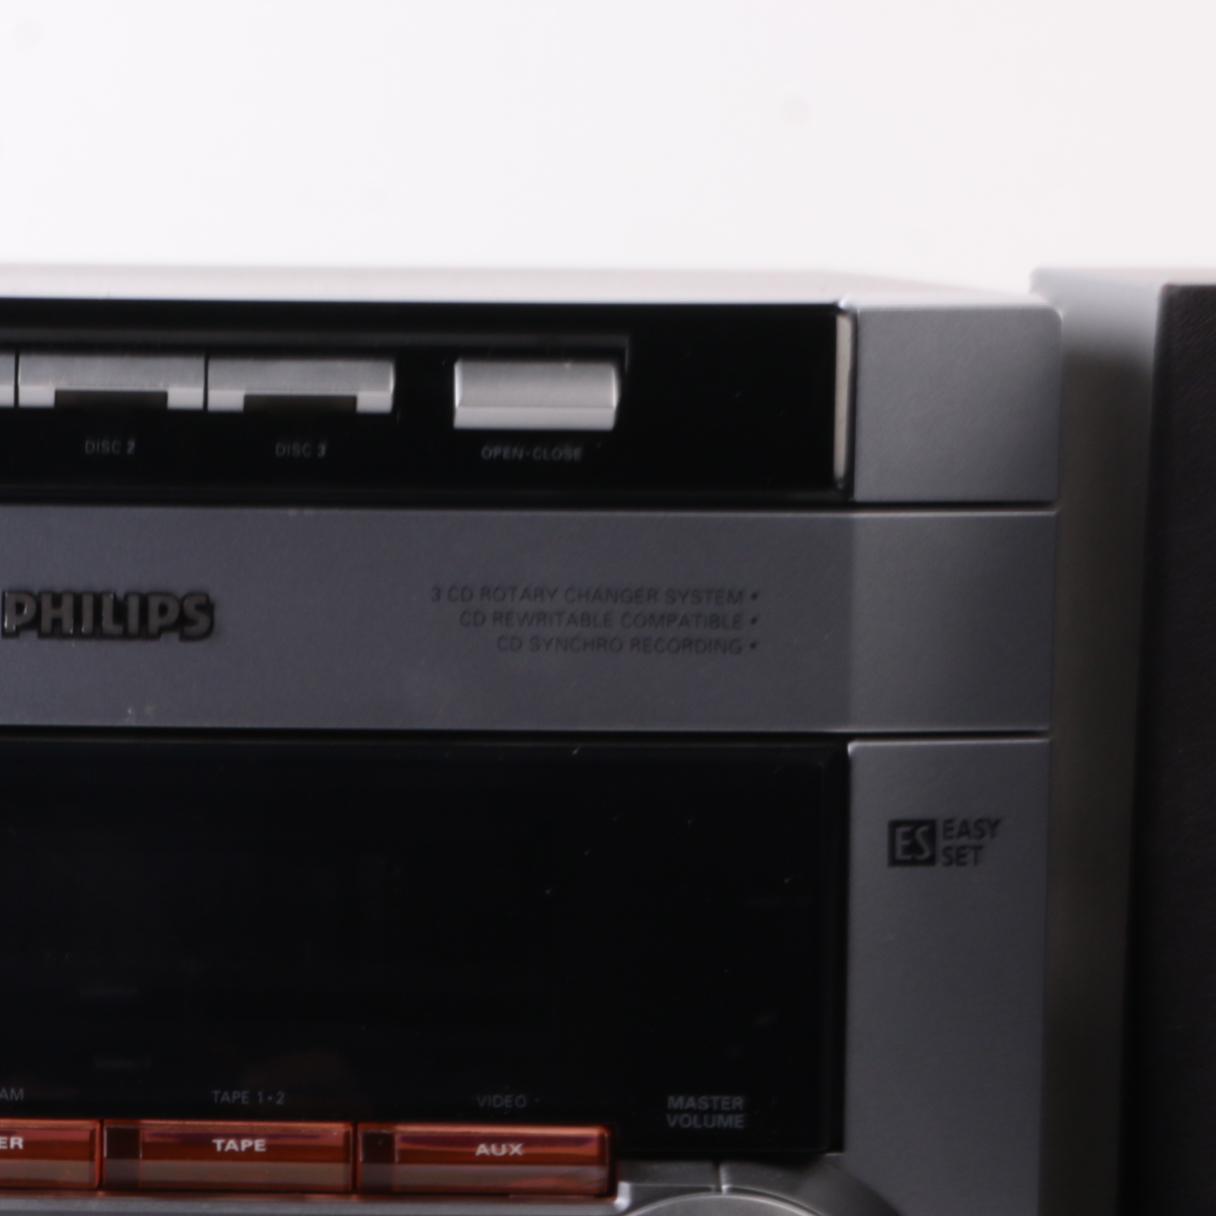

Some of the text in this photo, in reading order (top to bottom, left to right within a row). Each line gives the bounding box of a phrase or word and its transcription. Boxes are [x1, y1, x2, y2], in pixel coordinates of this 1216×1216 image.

[84, 438, 136, 455] DISC 2
[275, 441, 327, 459] DISC 3
[431, 588, 744, 605] 3 CD ROTARY CHANGER SYSTEM
[1, 590, 214, 641] PHILIPS
[459, 611, 742, 629] CD REWRITABLE COMPATIBLE
[497, 635, 742, 654] CD SYNCHRO RECORDING
[941, 818, 1002, 840] EASY
[892, 823, 933, 863] ES
[941, 845, 983, 867] SET
[212, 1089, 249, 1104] TAPE
[476, 1094, 526, 1110] VIDEO
[667, 1095, 744, 1111] MASTER
[666, 1113, 744, 1129] VOLUME
[212, 1138, 266, 1153] TAPE
[475, 1143, 524, 1157] AUX
